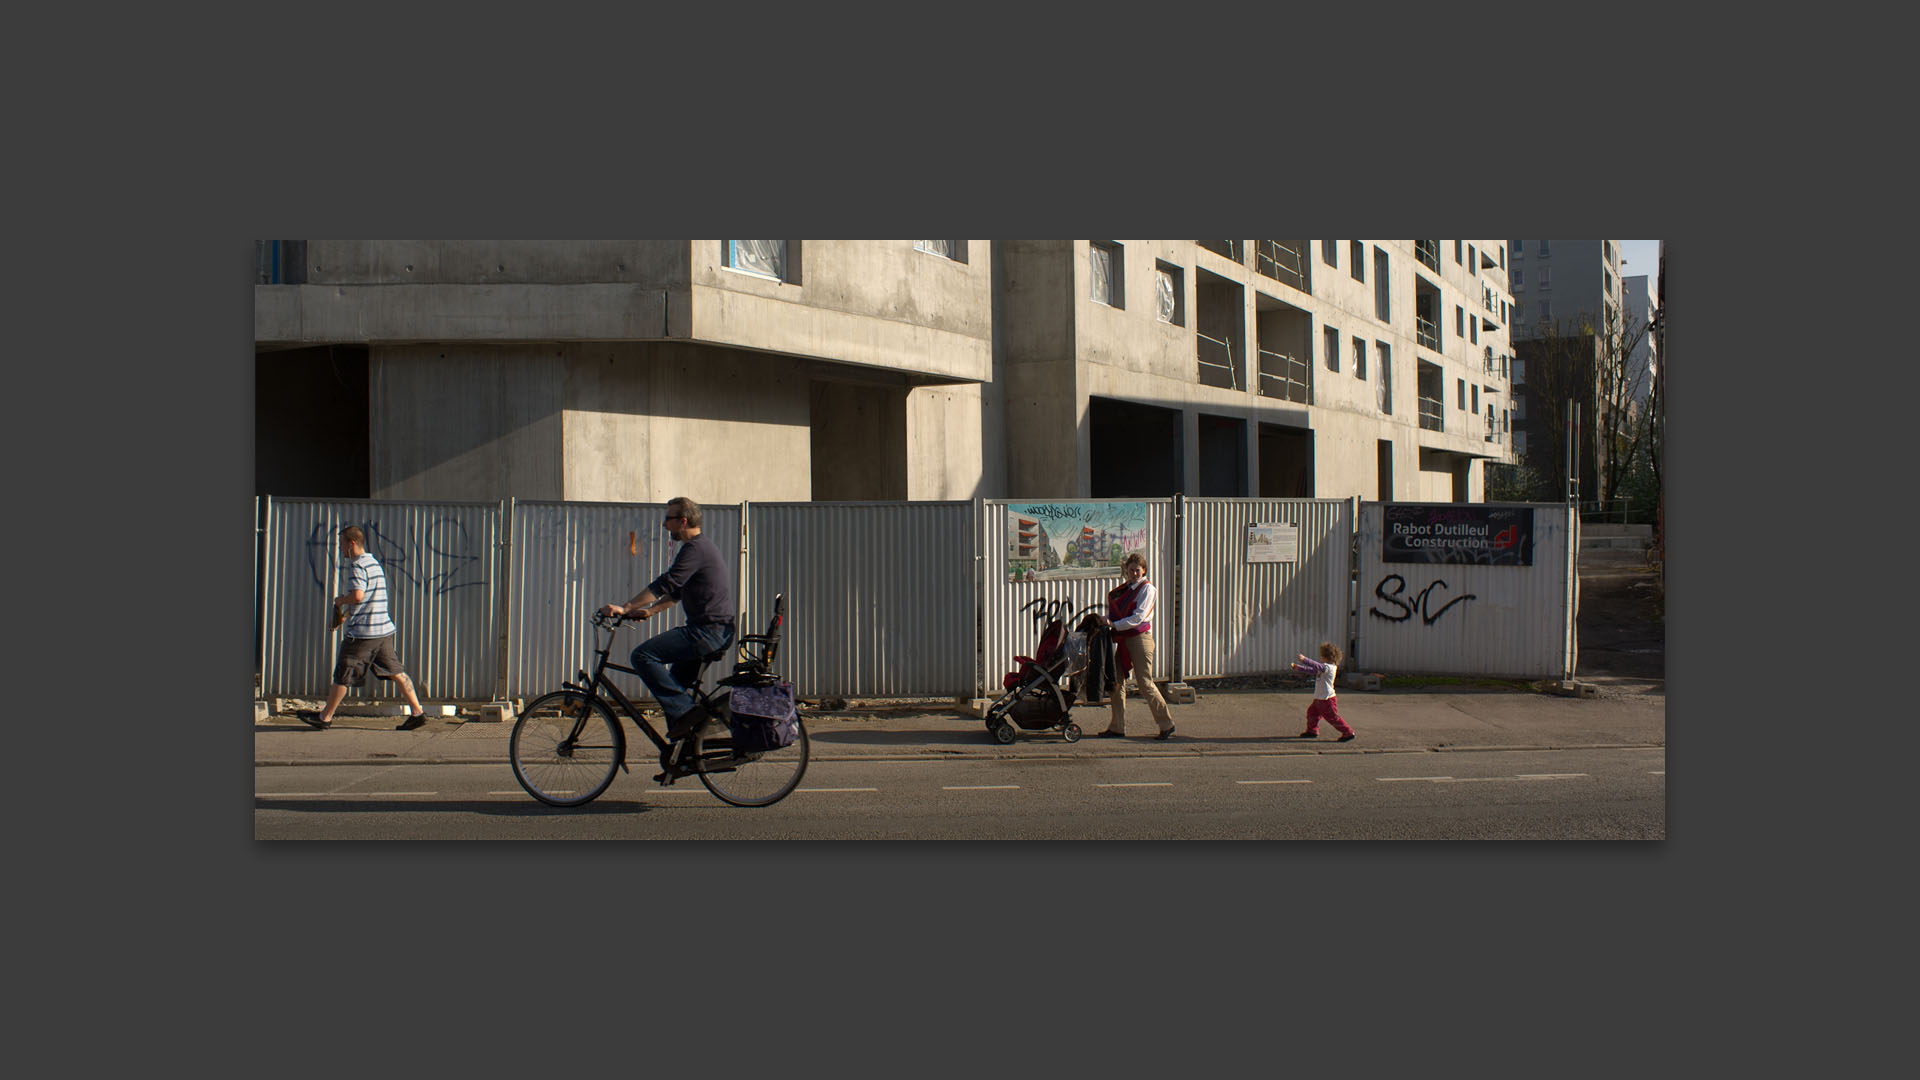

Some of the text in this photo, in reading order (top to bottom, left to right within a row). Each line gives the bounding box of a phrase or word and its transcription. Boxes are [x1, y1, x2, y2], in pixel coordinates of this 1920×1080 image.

[1393, 522, 1489, 537] Rabot Dutilleul
[1405, 535, 1489, 549] Construction
